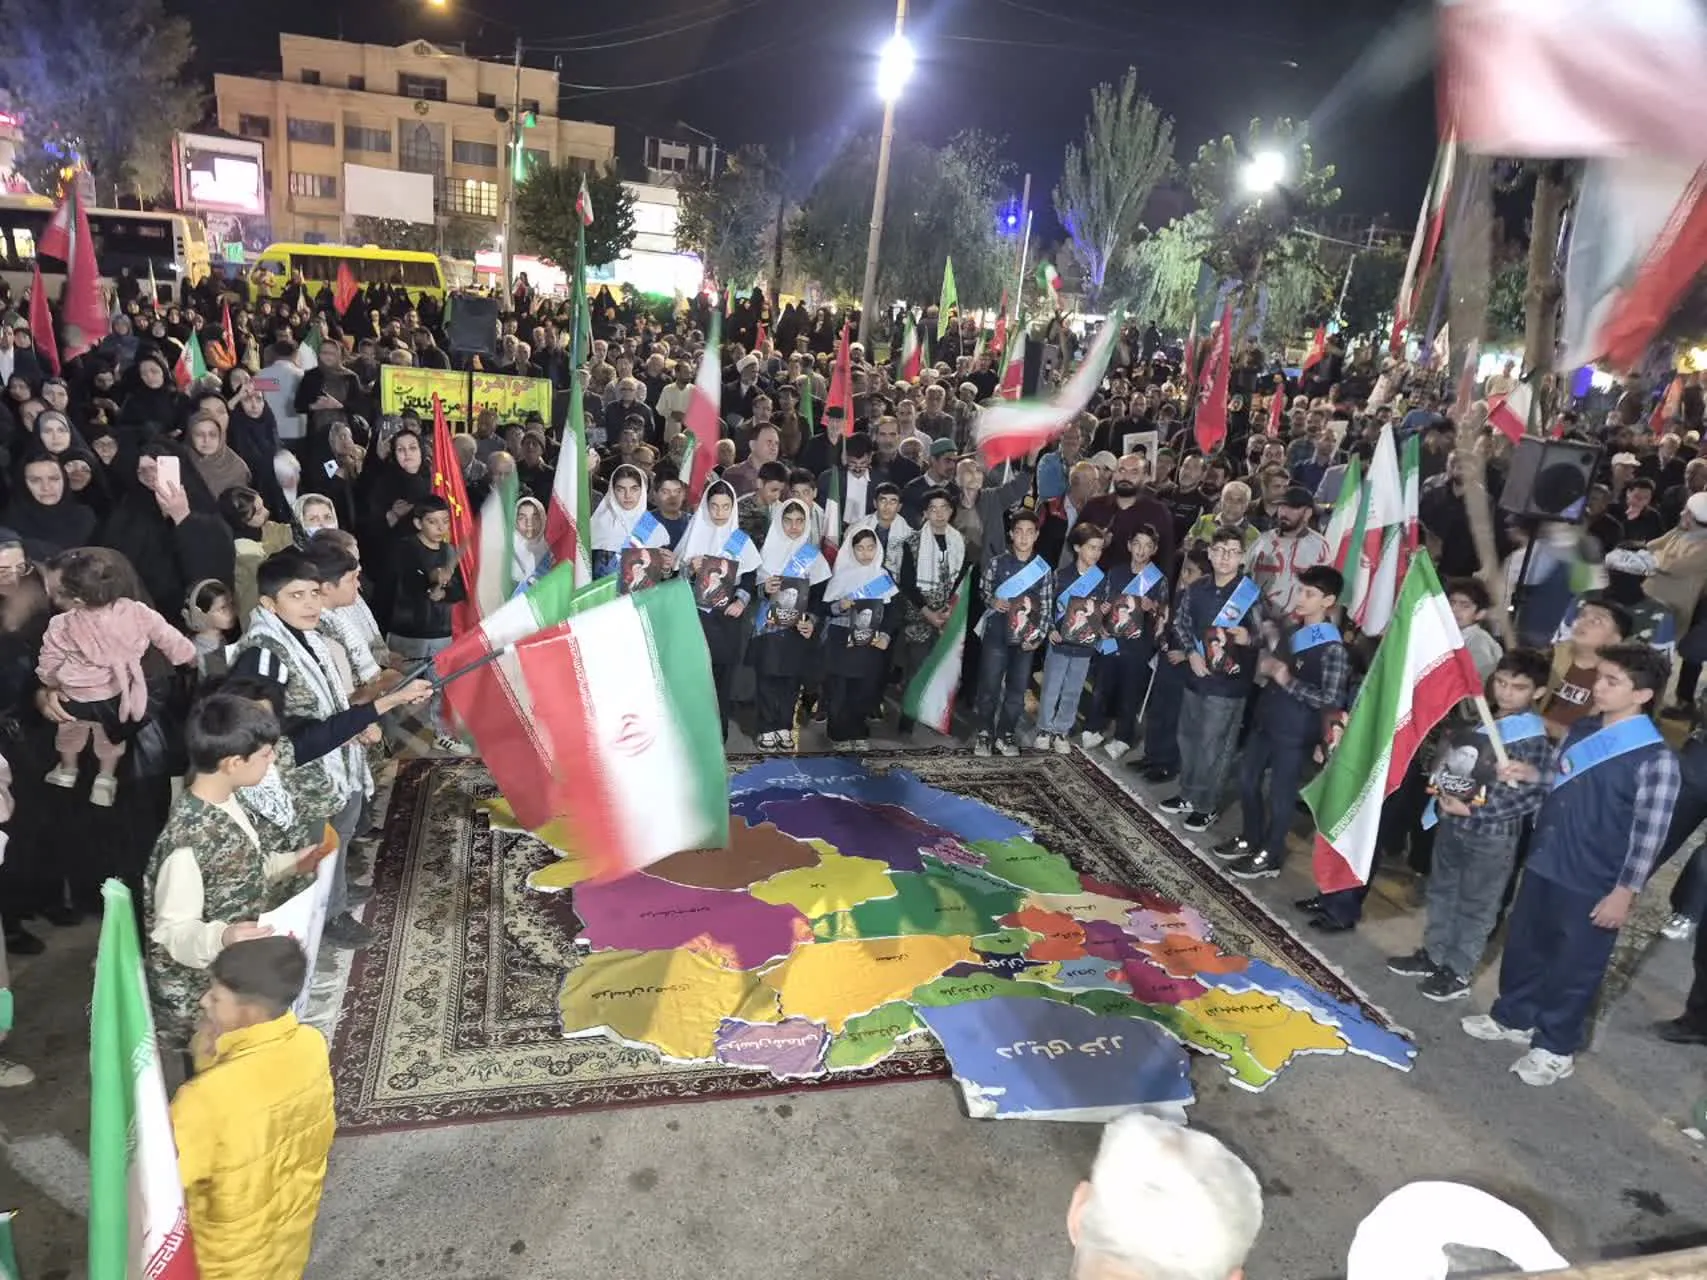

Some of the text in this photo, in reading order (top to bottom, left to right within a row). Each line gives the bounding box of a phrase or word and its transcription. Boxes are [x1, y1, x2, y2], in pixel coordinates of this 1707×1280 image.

[982, 957, 1025, 971] تهران
[716, 1032, 819, 1053] خراسان شمالی
[995, 1034, 1125, 1061] دریای خزر
